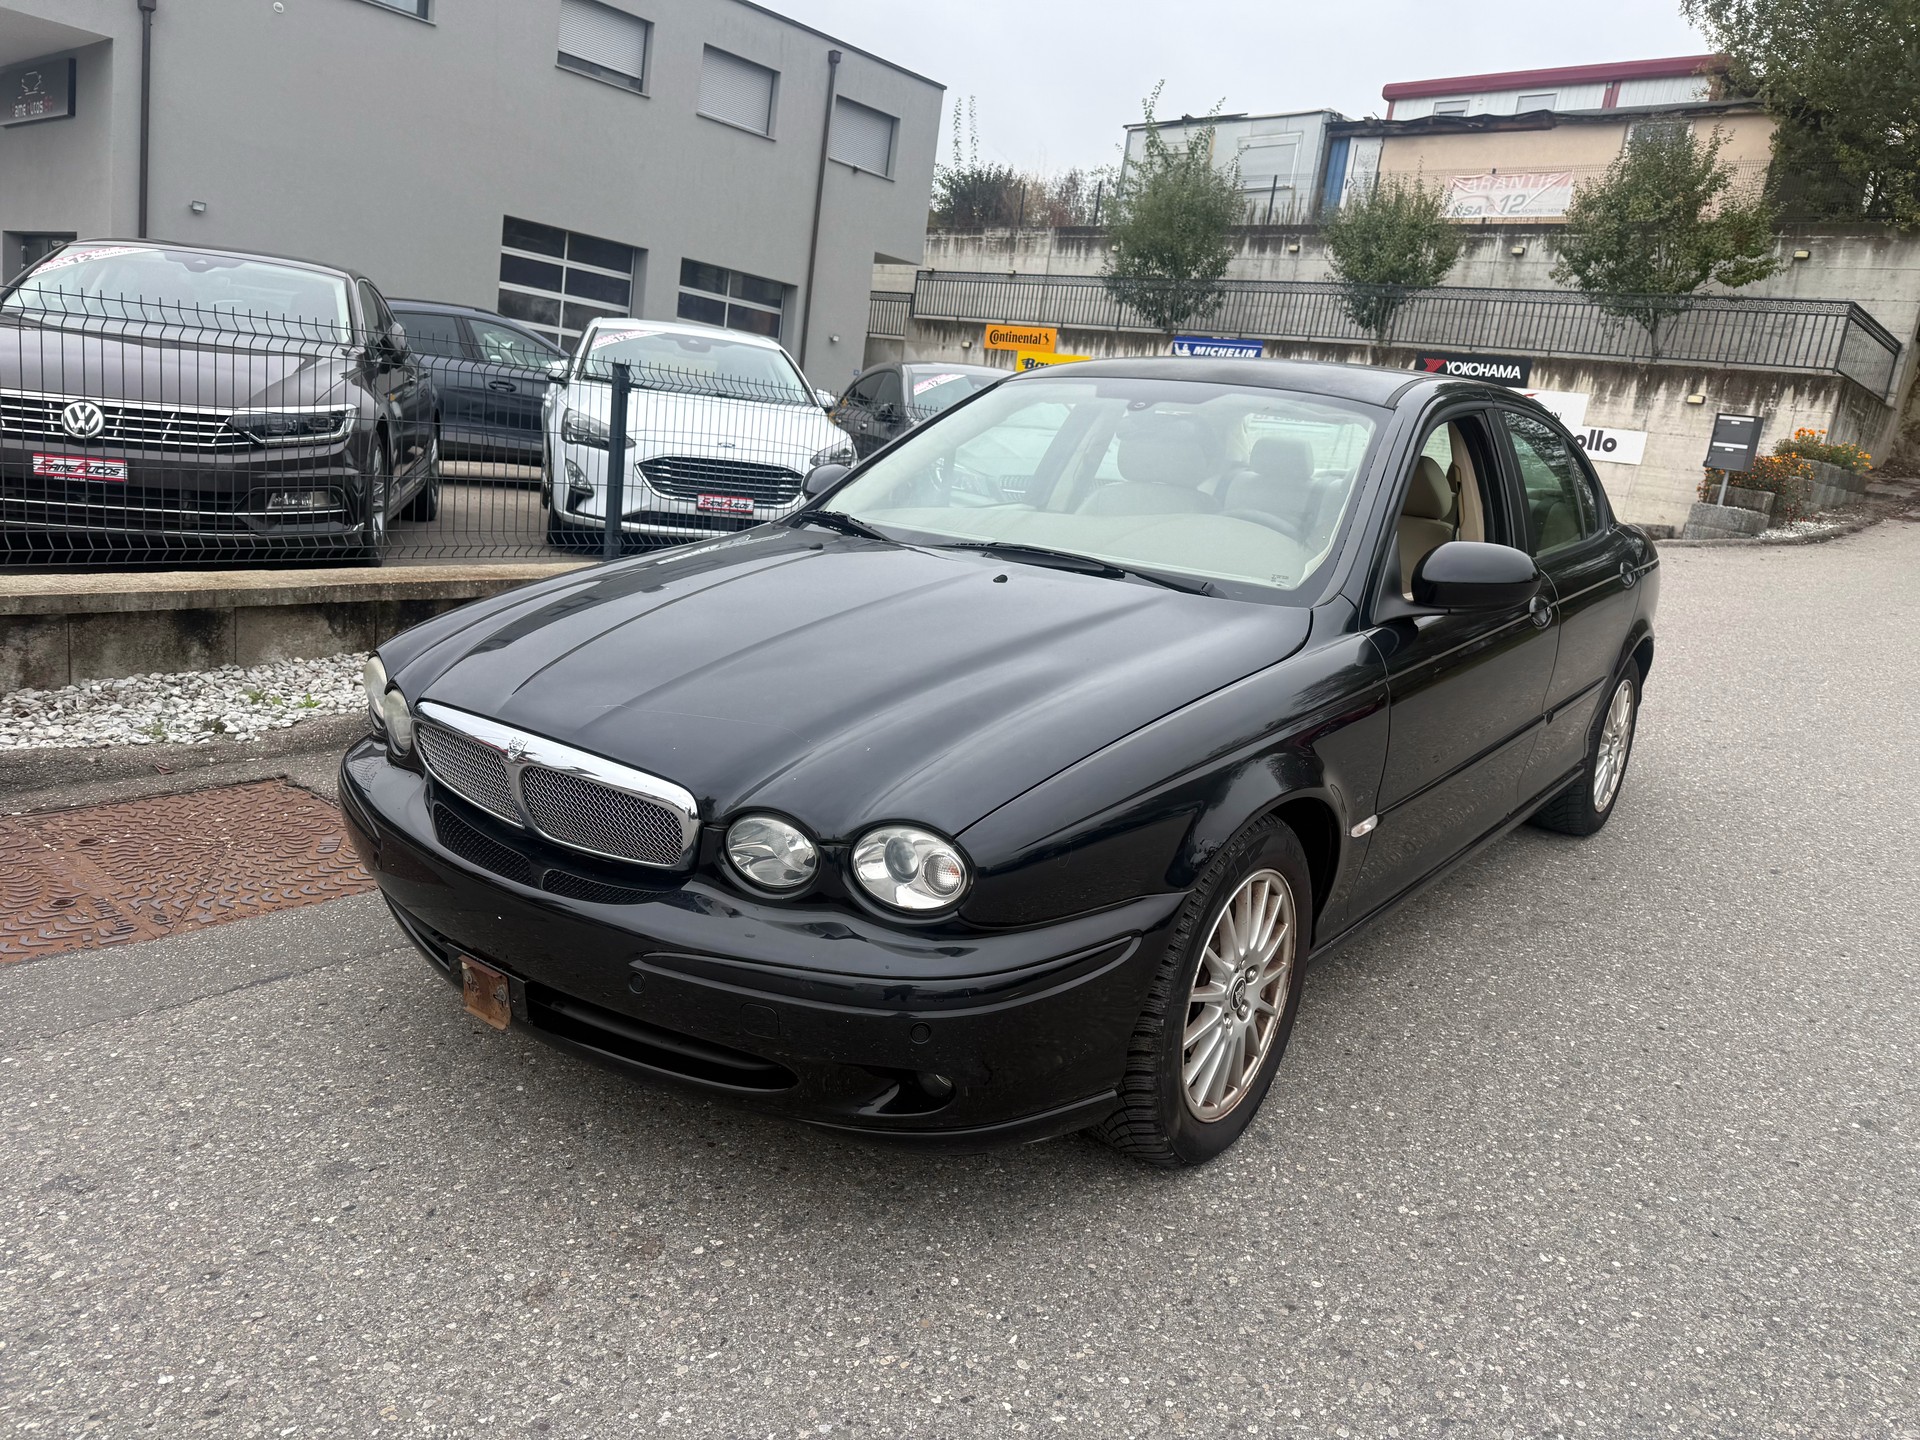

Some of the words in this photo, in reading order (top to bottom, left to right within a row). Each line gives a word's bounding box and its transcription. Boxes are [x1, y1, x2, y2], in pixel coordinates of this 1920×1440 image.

[1452, 171, 1562, 191] ARANTIE
[1500, 194, 1527, 214] 12
[990, 329, 1042, 345] Continental
[1193, 346, 1258, 358] MICHELIN
[1446, 360, 1521, 379] YOKOHAMA
[1574, 429, 1617, 453] ollo
